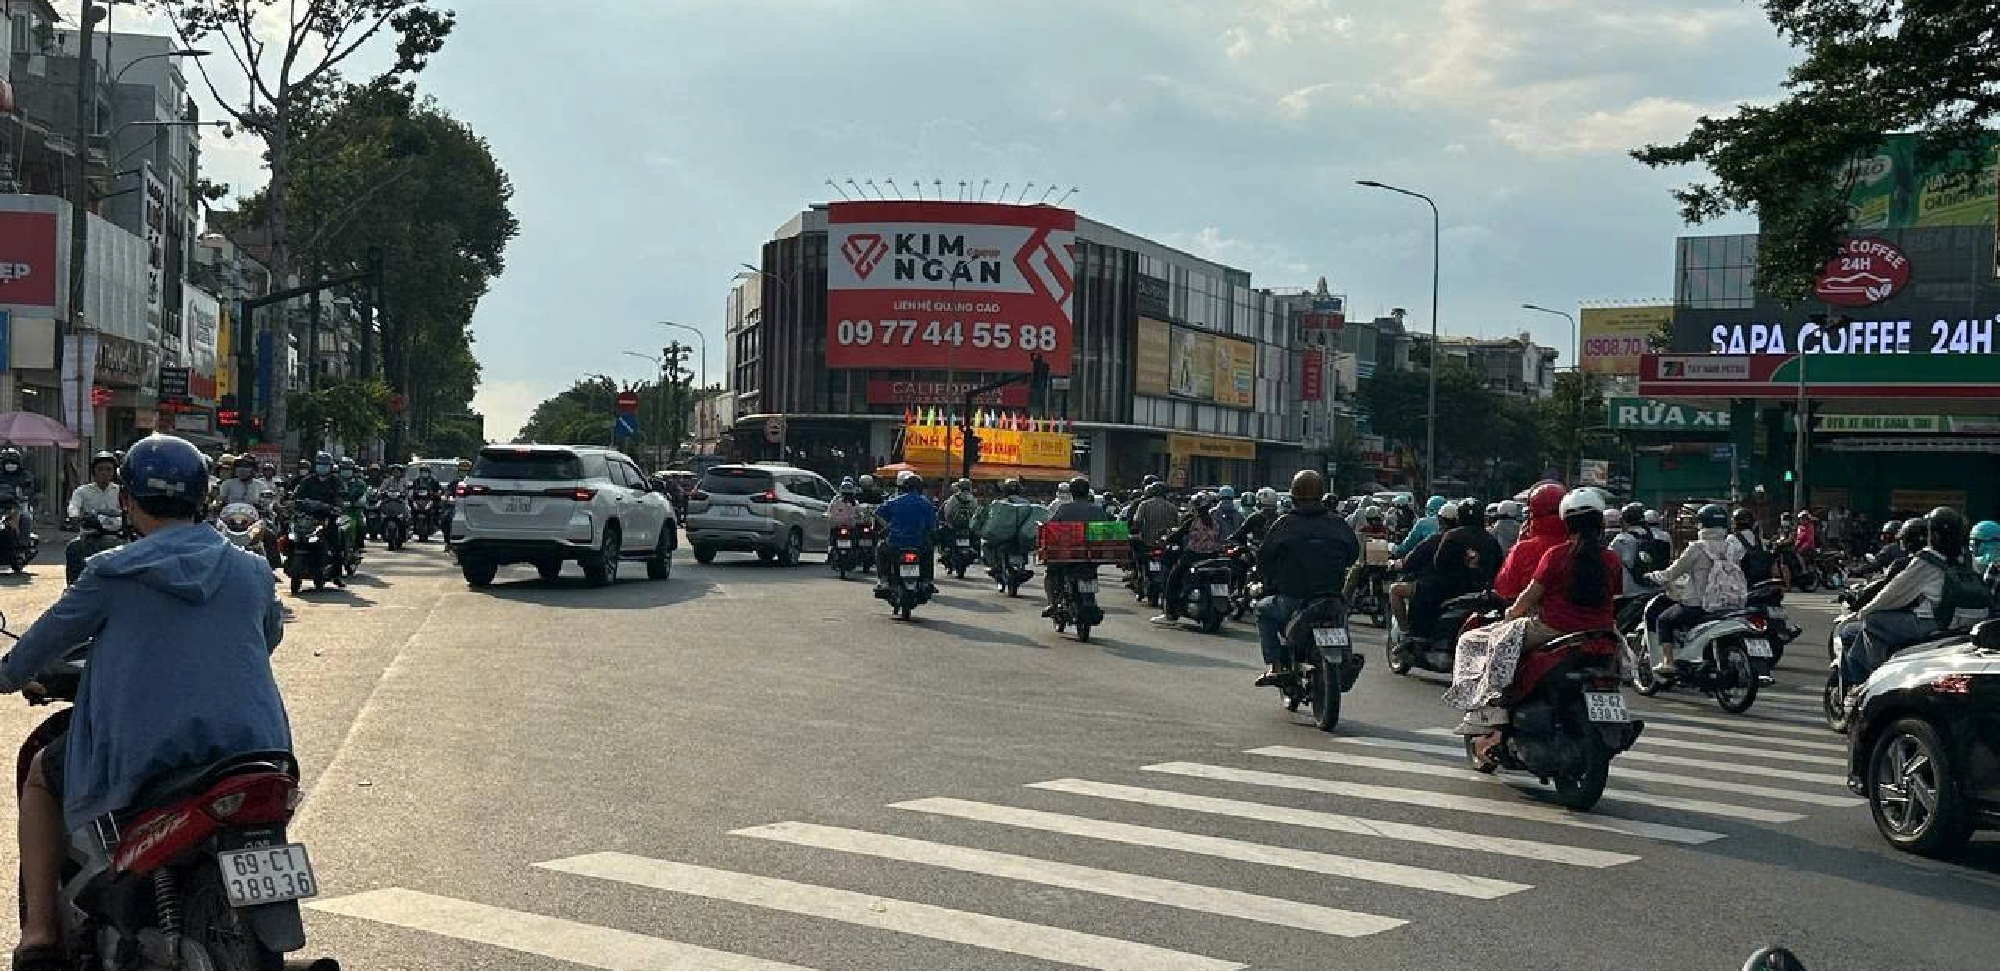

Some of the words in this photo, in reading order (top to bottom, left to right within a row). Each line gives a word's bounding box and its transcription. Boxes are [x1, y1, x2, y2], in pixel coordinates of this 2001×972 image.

[894, 233, 964, 256] KIM
[1850, 239, 1906, 270] COFFEE
[1841, 257, 1871, 270] 24H
[1711, 323, 1786, 354] SAPA
[1797, 321, 1911, 354] COFFEE
[1930, 318, 1992, 354] 24H
[230, 871, 311, 902] 389.36
